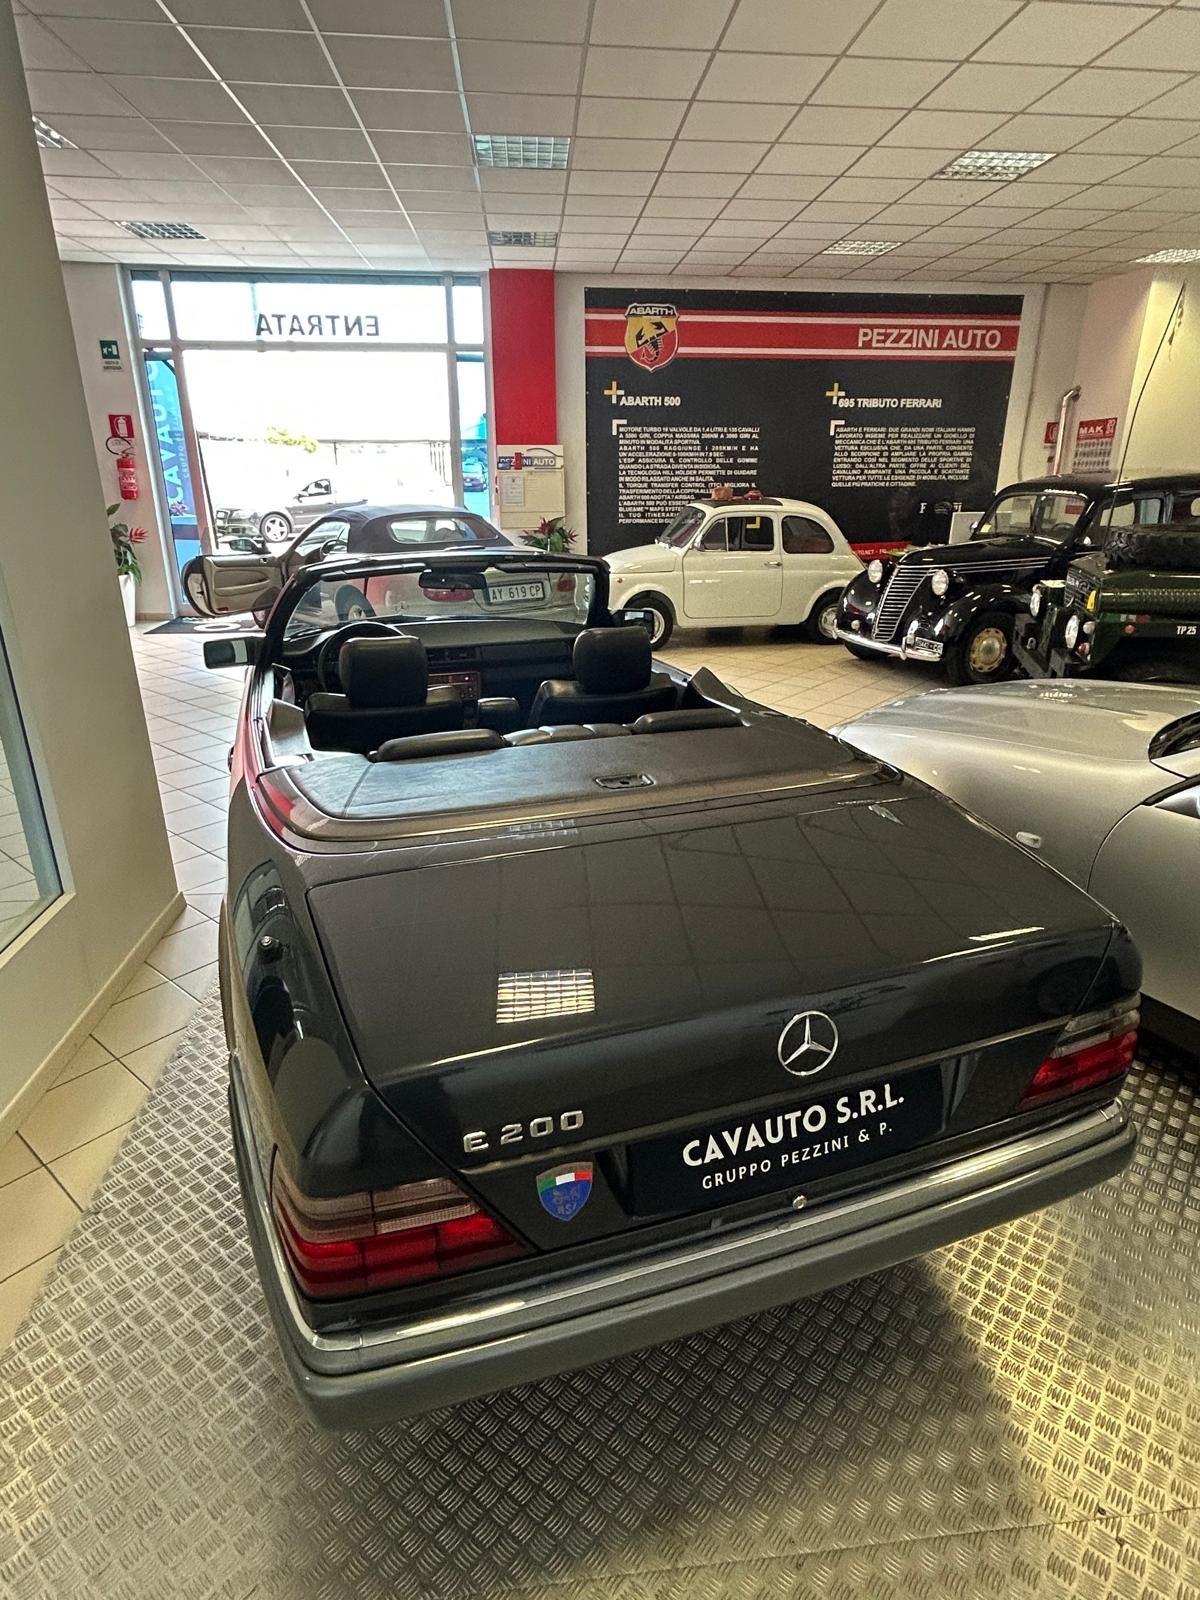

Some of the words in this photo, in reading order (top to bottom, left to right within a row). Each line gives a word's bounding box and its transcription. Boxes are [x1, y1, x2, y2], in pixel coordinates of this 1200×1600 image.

[629, 307, 674, 315] ABARTH
[857, 328, 939, 348] PEZZINI
[942, 329, 1001, 349] AUTO
[620, 396, 662, 406] ABARTH
[664, 396, 681, 406] 500
[838, 398, 855, 408] 695
[857, 398, 899, 408] TRIBUTO
[900, 399, 942, 408] FERRARI
[533, 458, 555, 466] AUTO
[508, 585, 527, 599] 619
[529, 584, 541, 597] CP
[1176, 625, 1187, 635] TP
[1186, 625, 1198, 635] 25
[463, 1130, 489, 1153] E
[500, 1109, 584, 1145] 200
[682, 1104, 827, 1167] CAVAUTO
[836, 1083, 905, 1124] S.R.L.
[702, 1159, 771, 1189] GRUPPO
[780, 1135, 849, 1167] PEZZINI
[858, 1129, 870, 1142] &
[879, 1122, 893, 1135] P.
